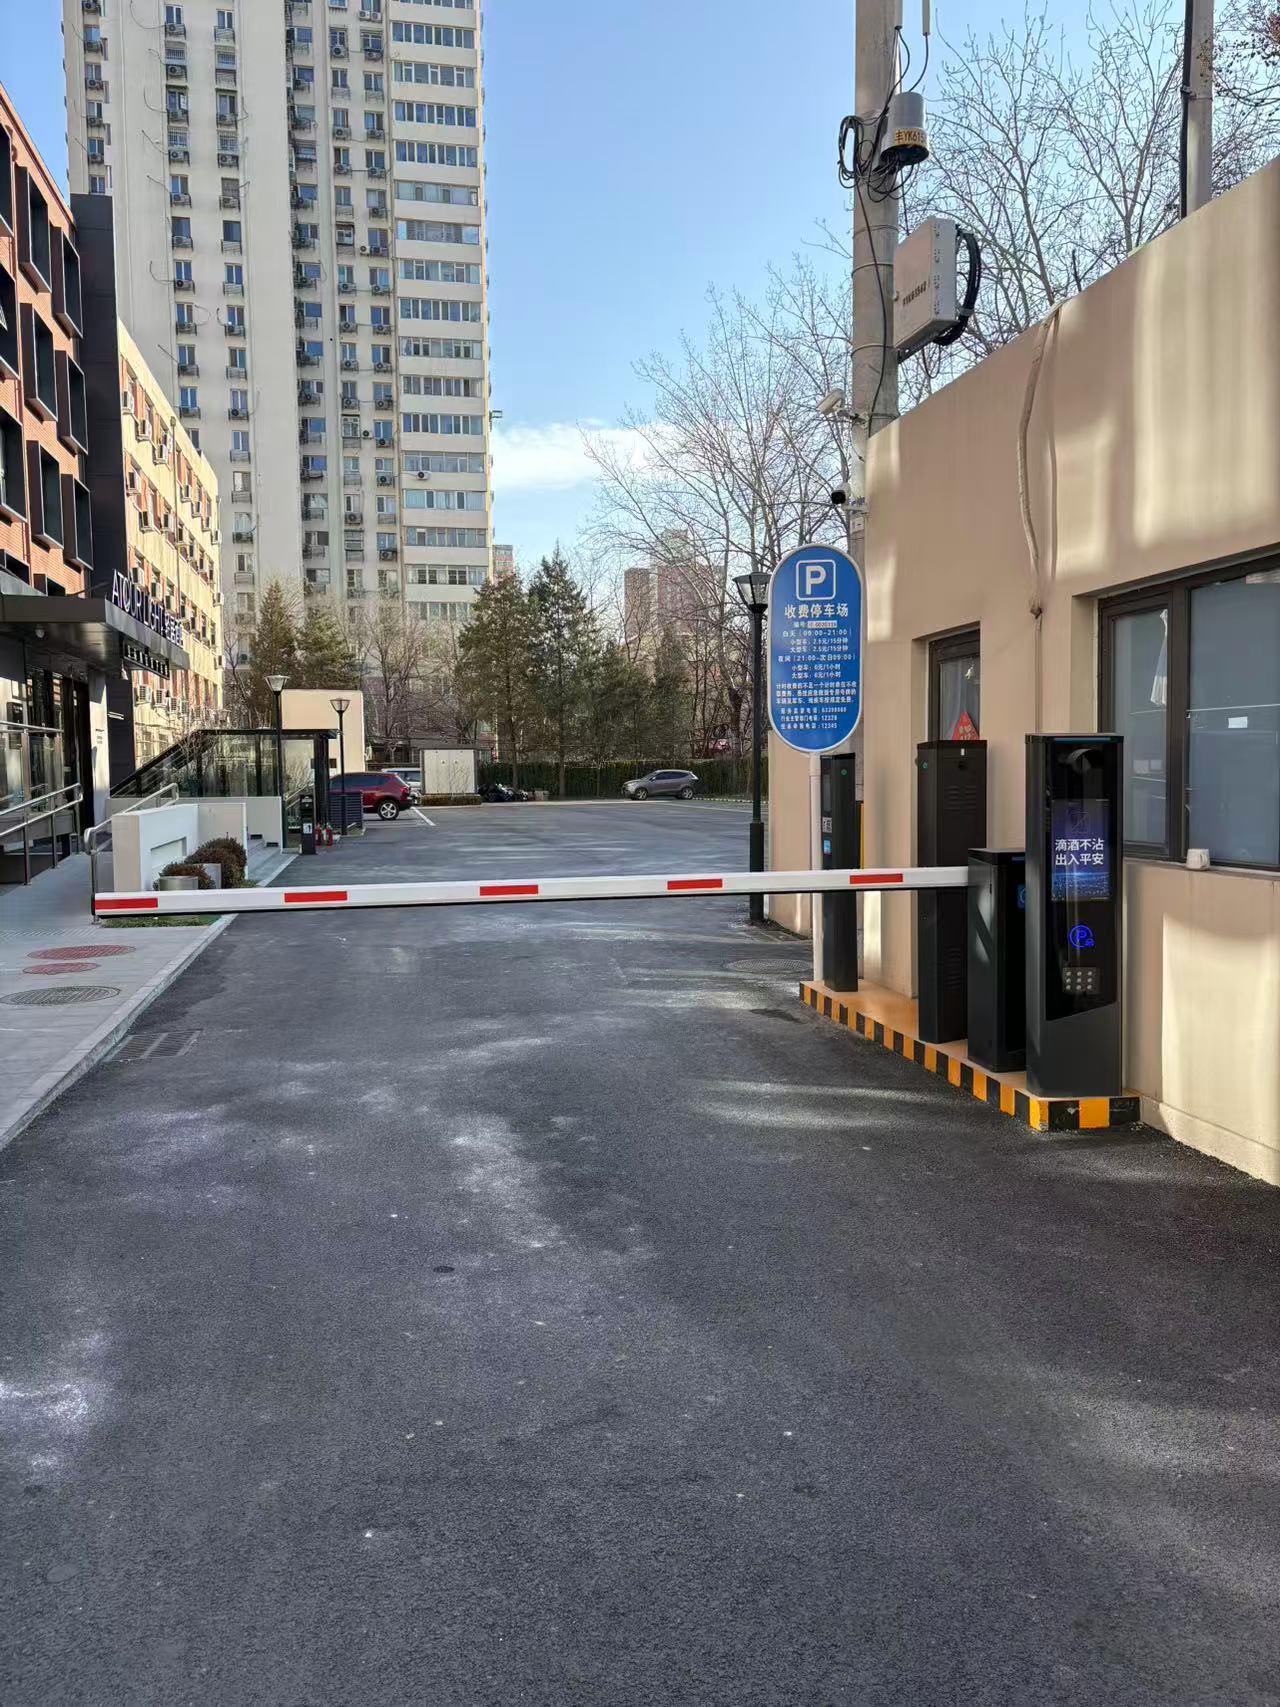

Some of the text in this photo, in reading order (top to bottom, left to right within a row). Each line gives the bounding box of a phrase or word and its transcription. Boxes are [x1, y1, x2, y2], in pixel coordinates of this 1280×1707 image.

[805, 565, 827, 595] P
[784, 603, 849, 619] 收费停车场
[1055, 837, 1105, 851] 滴酒不沾
[1055, 852, 1104, 865] 出入平安
